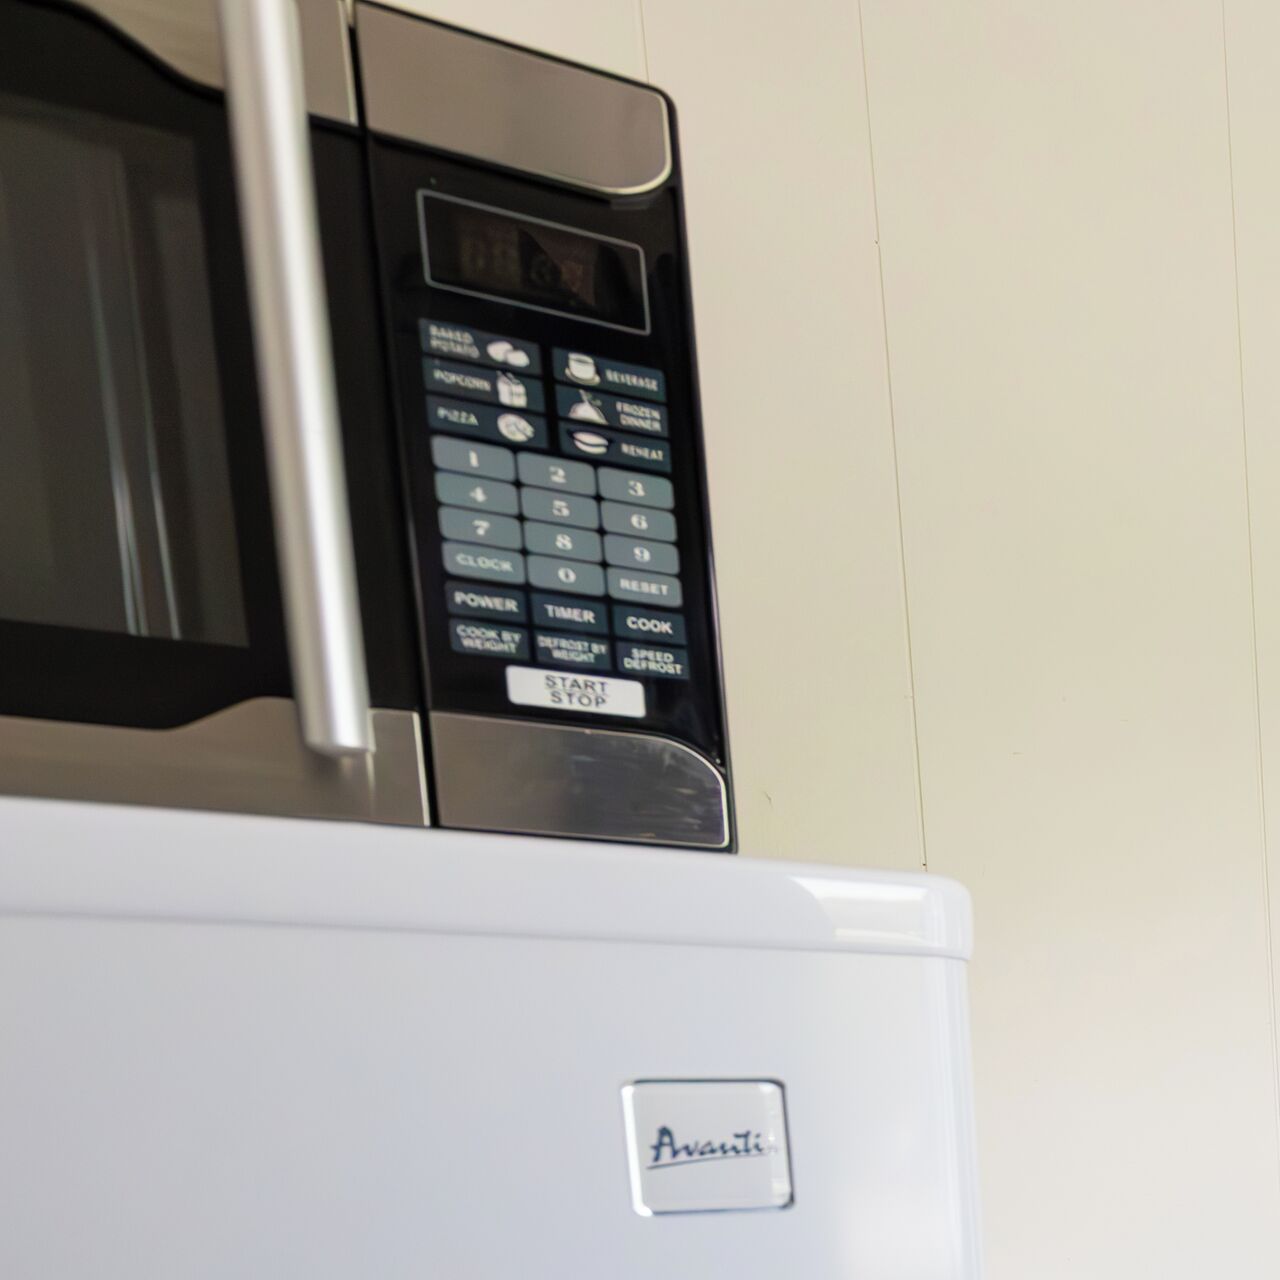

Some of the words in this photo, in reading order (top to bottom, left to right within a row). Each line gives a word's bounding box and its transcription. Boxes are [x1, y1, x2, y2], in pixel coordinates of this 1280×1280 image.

[433, 368, 492, 392] POPCORN
[605, 368, 659, 392] BEVERAGE
[436, 406, 479, 426] PIZZA
[615, 401, 661, 420] FROZEN
[619, 413, 662, 433] DINNER
[468, 450, 479, 467] 1
[549, 466, 566, 483] 2
[469, 486, 487, 503] 4
[628, 480, 645, 497] 3
[552, 500, 570, 517] 5
[472, 519, 490, 536] 7
[631, 513, 648, 530] 6
[555, 533, 573, 550] 8
[456, 553, 513, 572] CLOCK
[633, 546, 651, 563] 9
[558, 567, 577, 584] 0
[619, 578, 669, 596] RESET
[454, 591, 518, 612] POWER
[543, 603, 596, 624] TIMER
[456, 624, 500, 641] COOK
[501, 630, 521, 643] BY
[626, 616, 674, 635] COOK
[461, 637, 517, 654] WEIGHT
[536, 635, 589, 652] DEFROST
[590, 642, 608, 655] BY
[551, 649, 596, 663] WEIGHT
[631, 648, 674, 663] SPEED
[623, 657, 684, 675] DEFROST
[544, 674, 609, 694] START
[550, 690, 608, 708] STOP
[650, 1125, 764, 1163] Avanti
